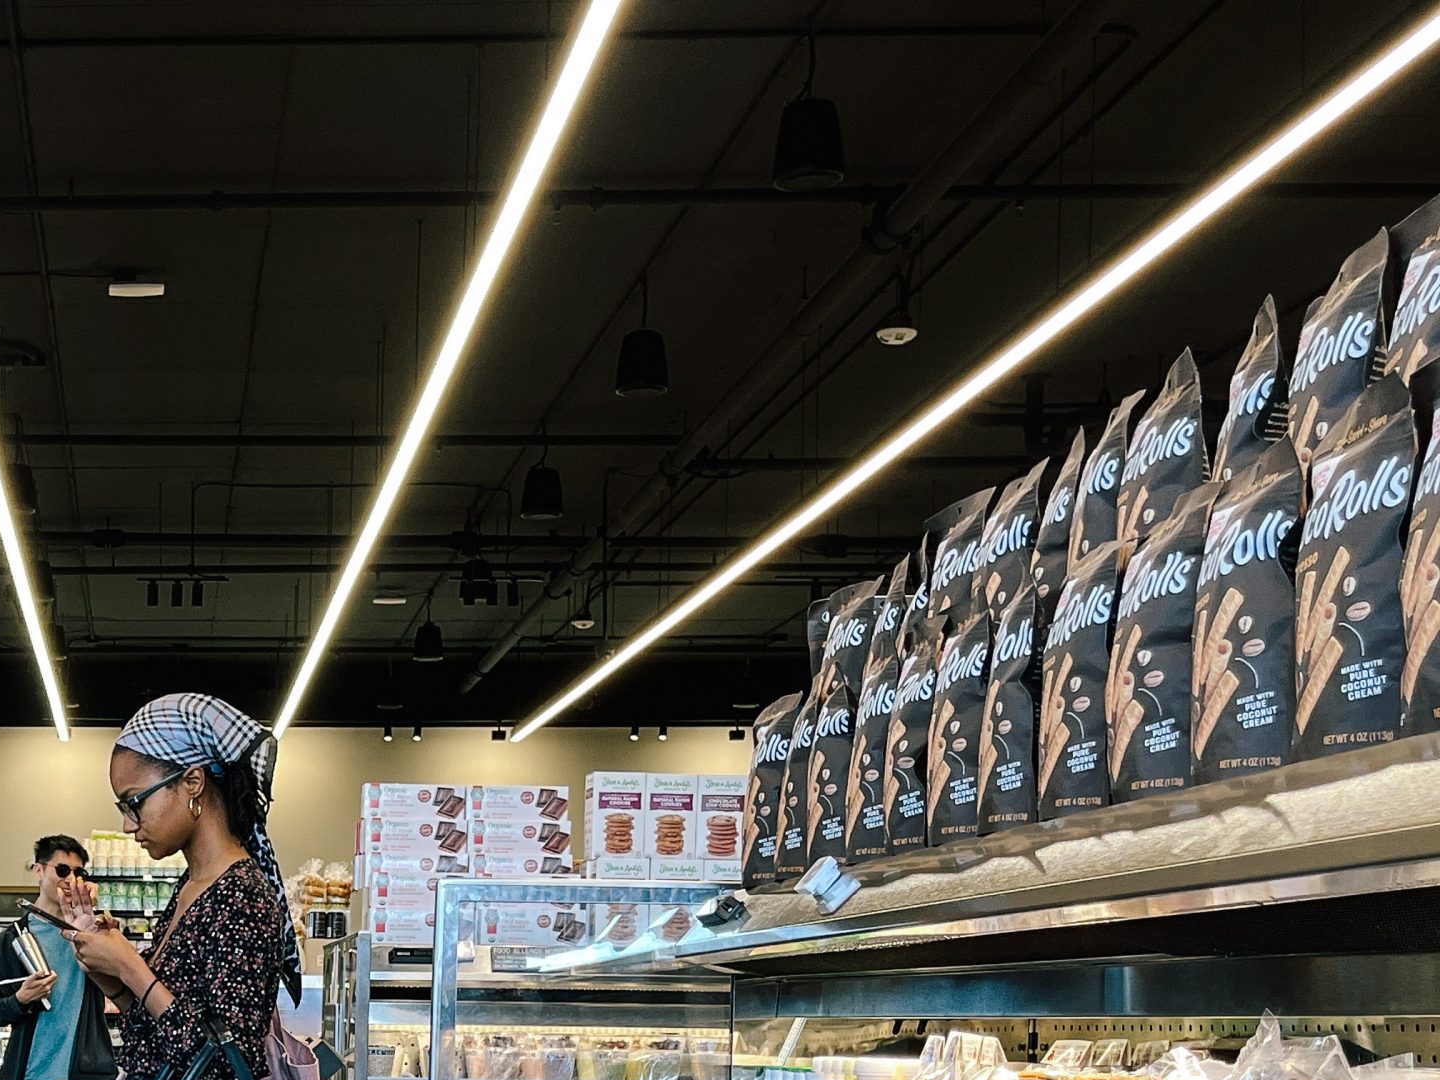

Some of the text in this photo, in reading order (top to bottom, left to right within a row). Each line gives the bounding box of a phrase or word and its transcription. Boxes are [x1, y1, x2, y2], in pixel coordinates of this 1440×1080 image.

[1340, 659, 1383, 675] MADE WITH
[1349, 669, 1375, 681] PURE
[1340, 675, 1387, 694] COCONUT
[1347, 686, 1382, 701] CREAM
[1245, 700, 1267, 711] PURE
[1236, 705, 1278, 723] COCONUT
[1242, 716, 1273, 729] CREAM
[1357, 732, 1368, 742] OZ
[1248, 757, 1259, 767] OZ
